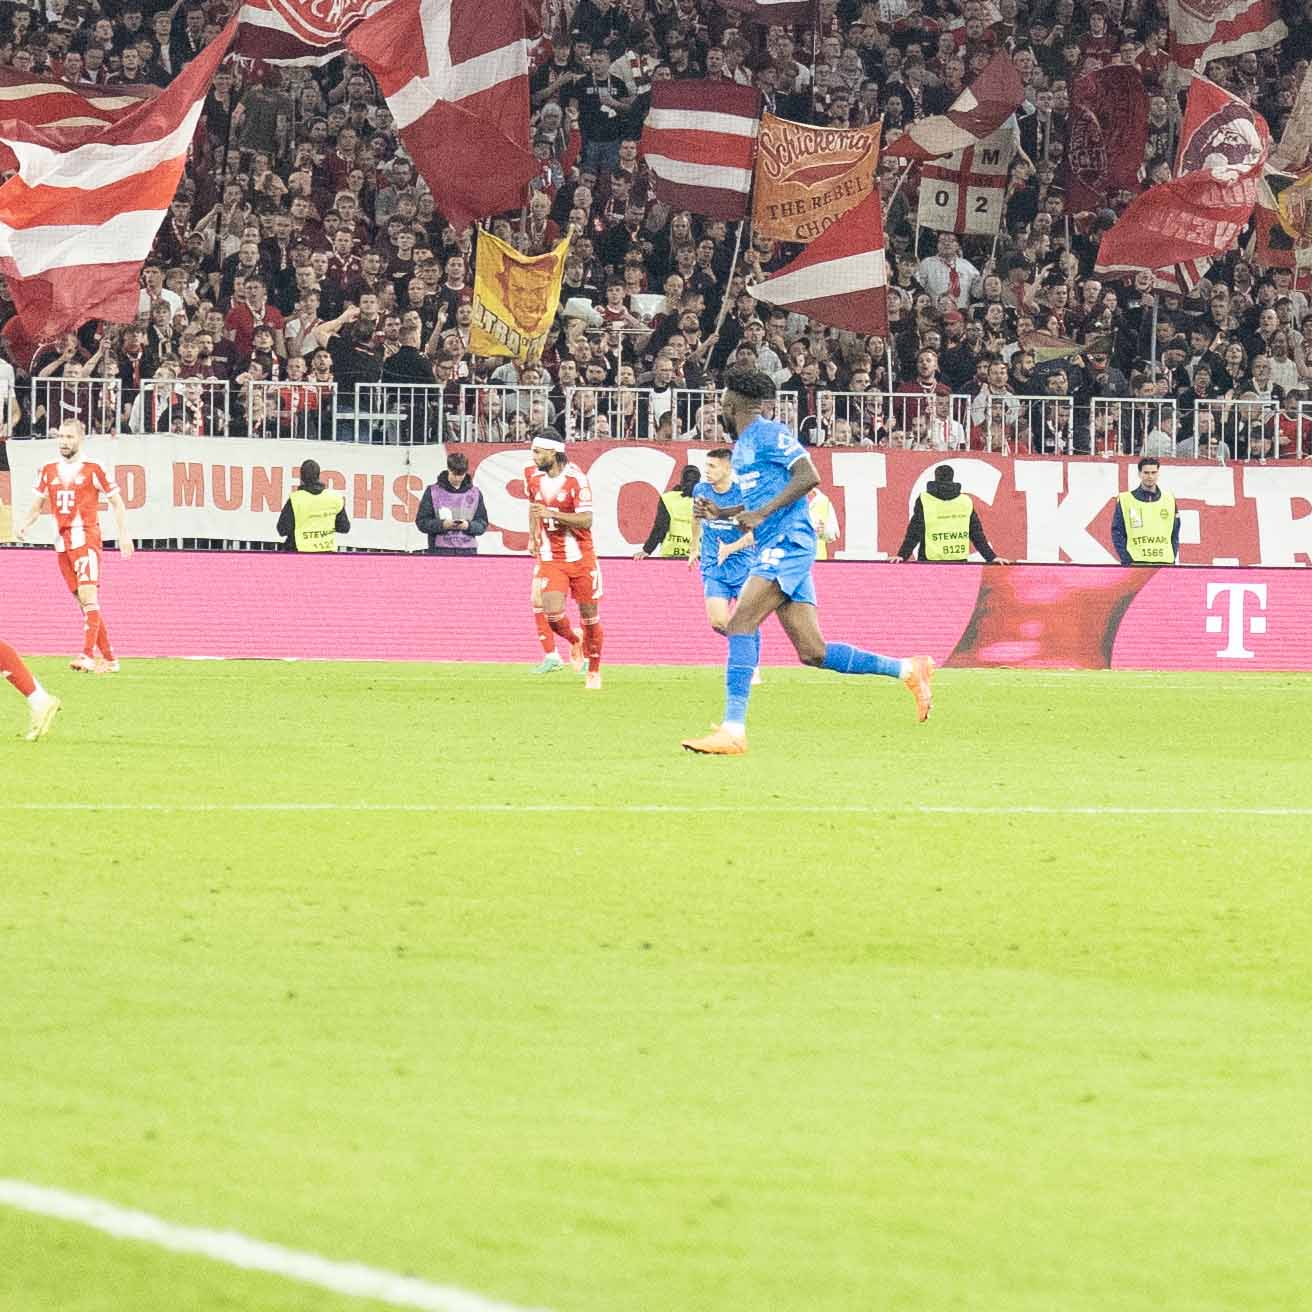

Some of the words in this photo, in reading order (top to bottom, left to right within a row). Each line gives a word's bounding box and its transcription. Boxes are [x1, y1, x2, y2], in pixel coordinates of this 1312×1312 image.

[766, 199, 807, 220] THE
[931, 531, 969, 542] STEWAR
[1132, 535, 1169, 546] STEWAR
[1205, 582, 1268, 659] T
